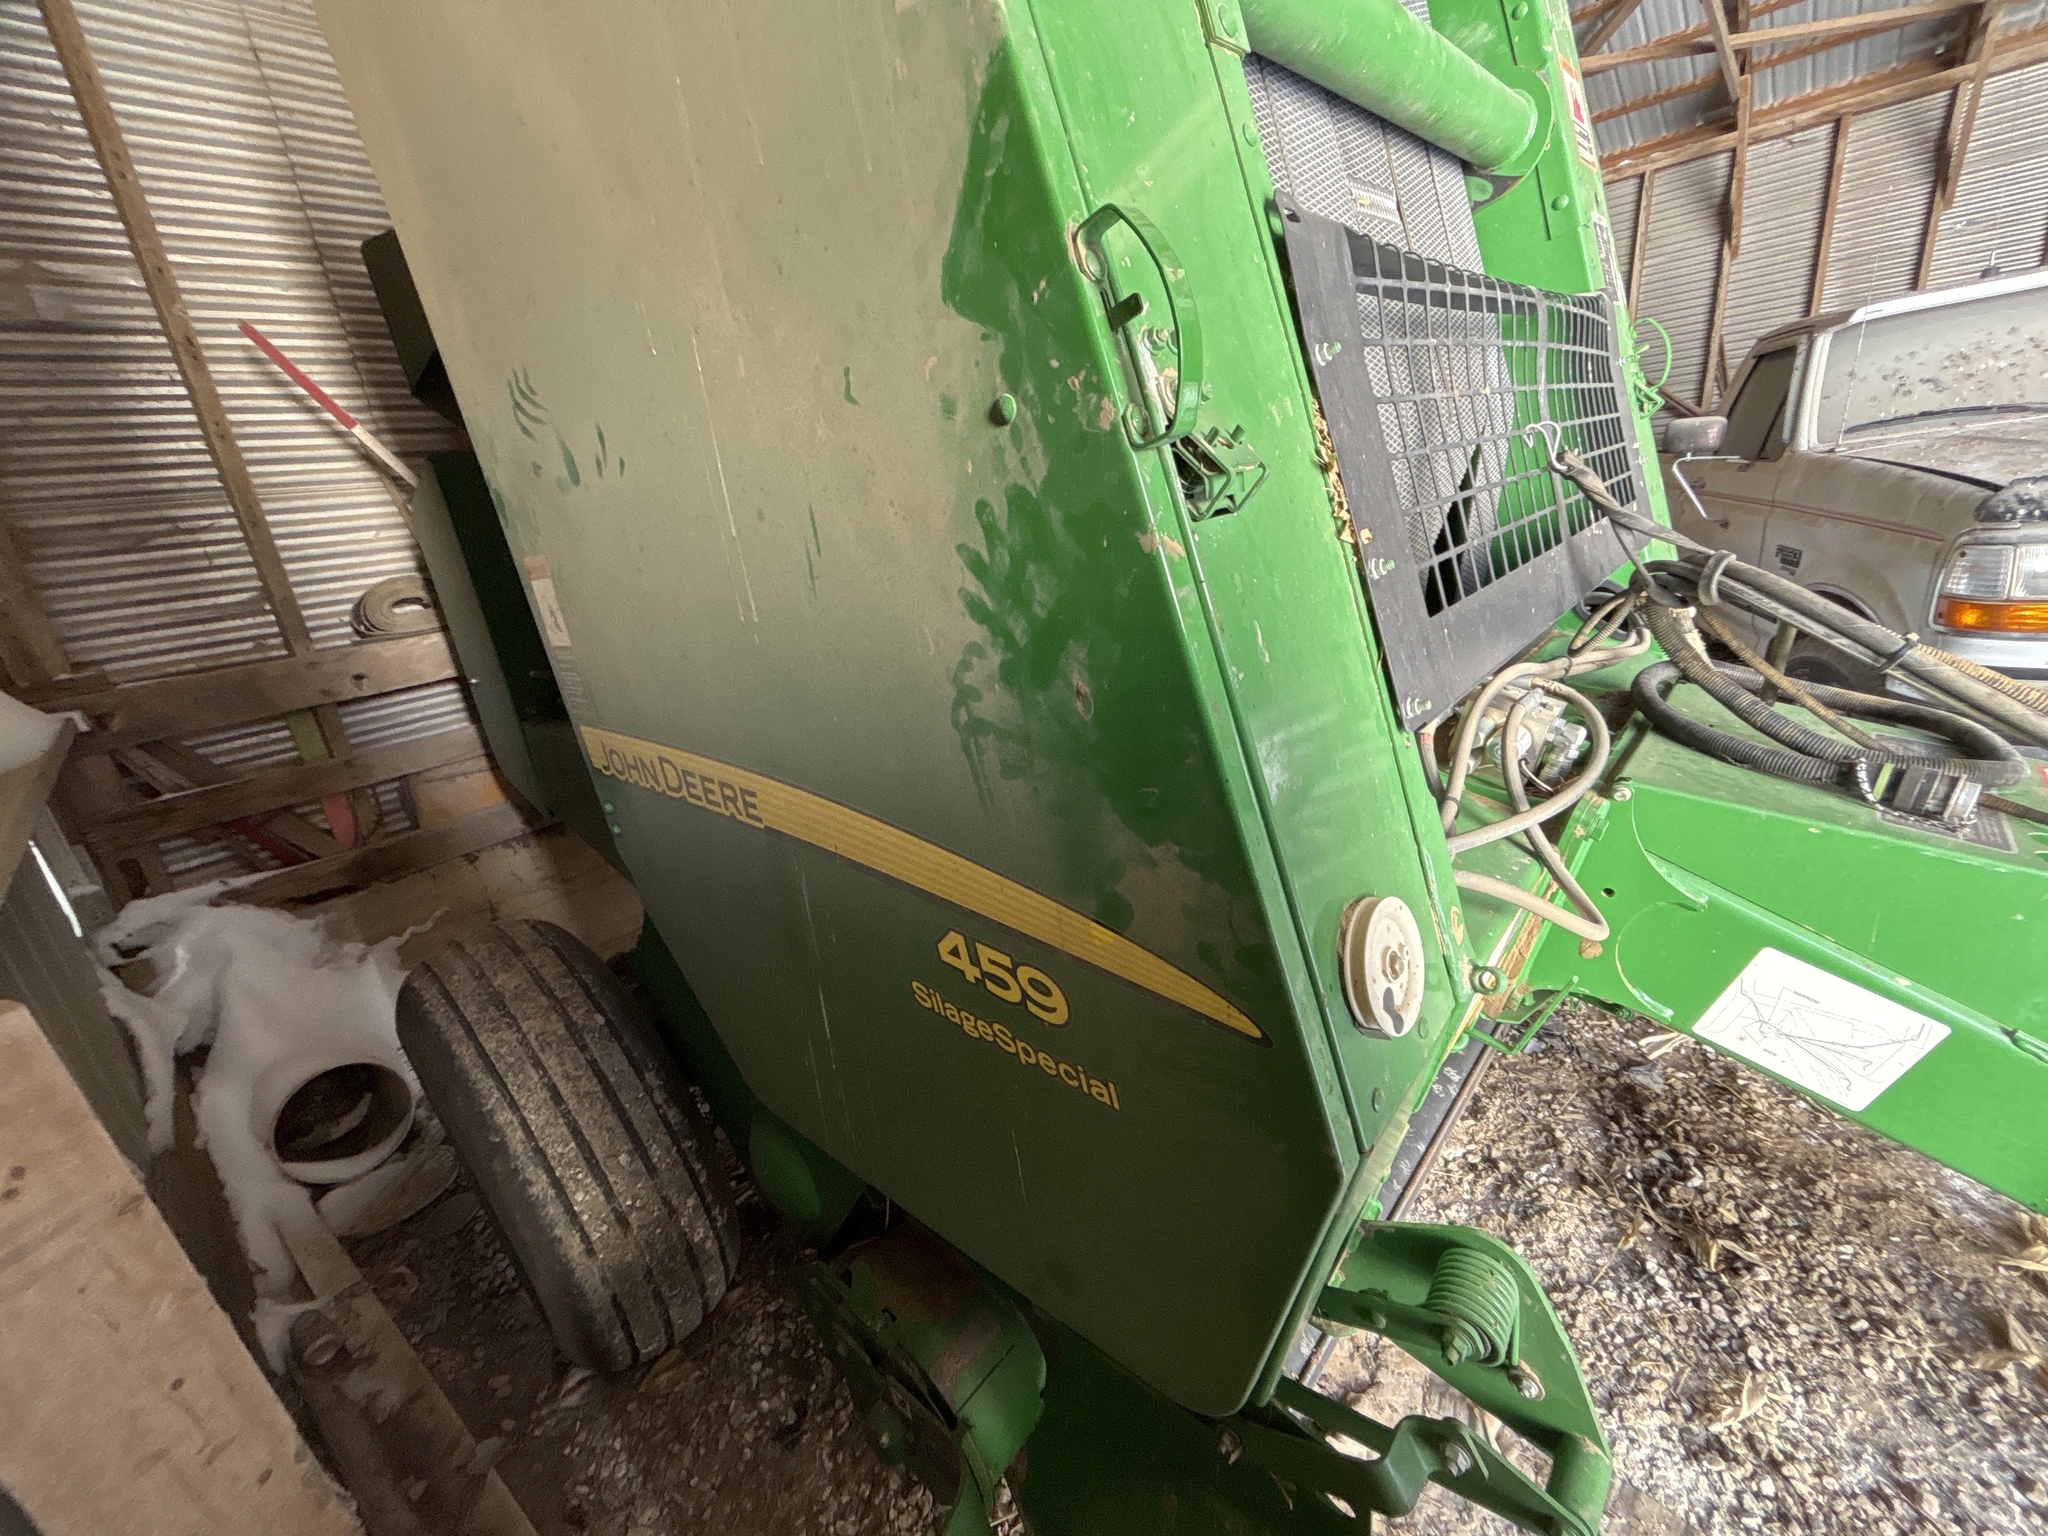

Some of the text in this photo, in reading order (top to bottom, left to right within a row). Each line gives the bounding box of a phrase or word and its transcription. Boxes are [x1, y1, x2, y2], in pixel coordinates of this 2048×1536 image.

[600, 740, 764, 824] JOHN DEERE
[937, 930, 1070, 1026] 459
[911, 980, 1121, 1111] SilageSpecial
